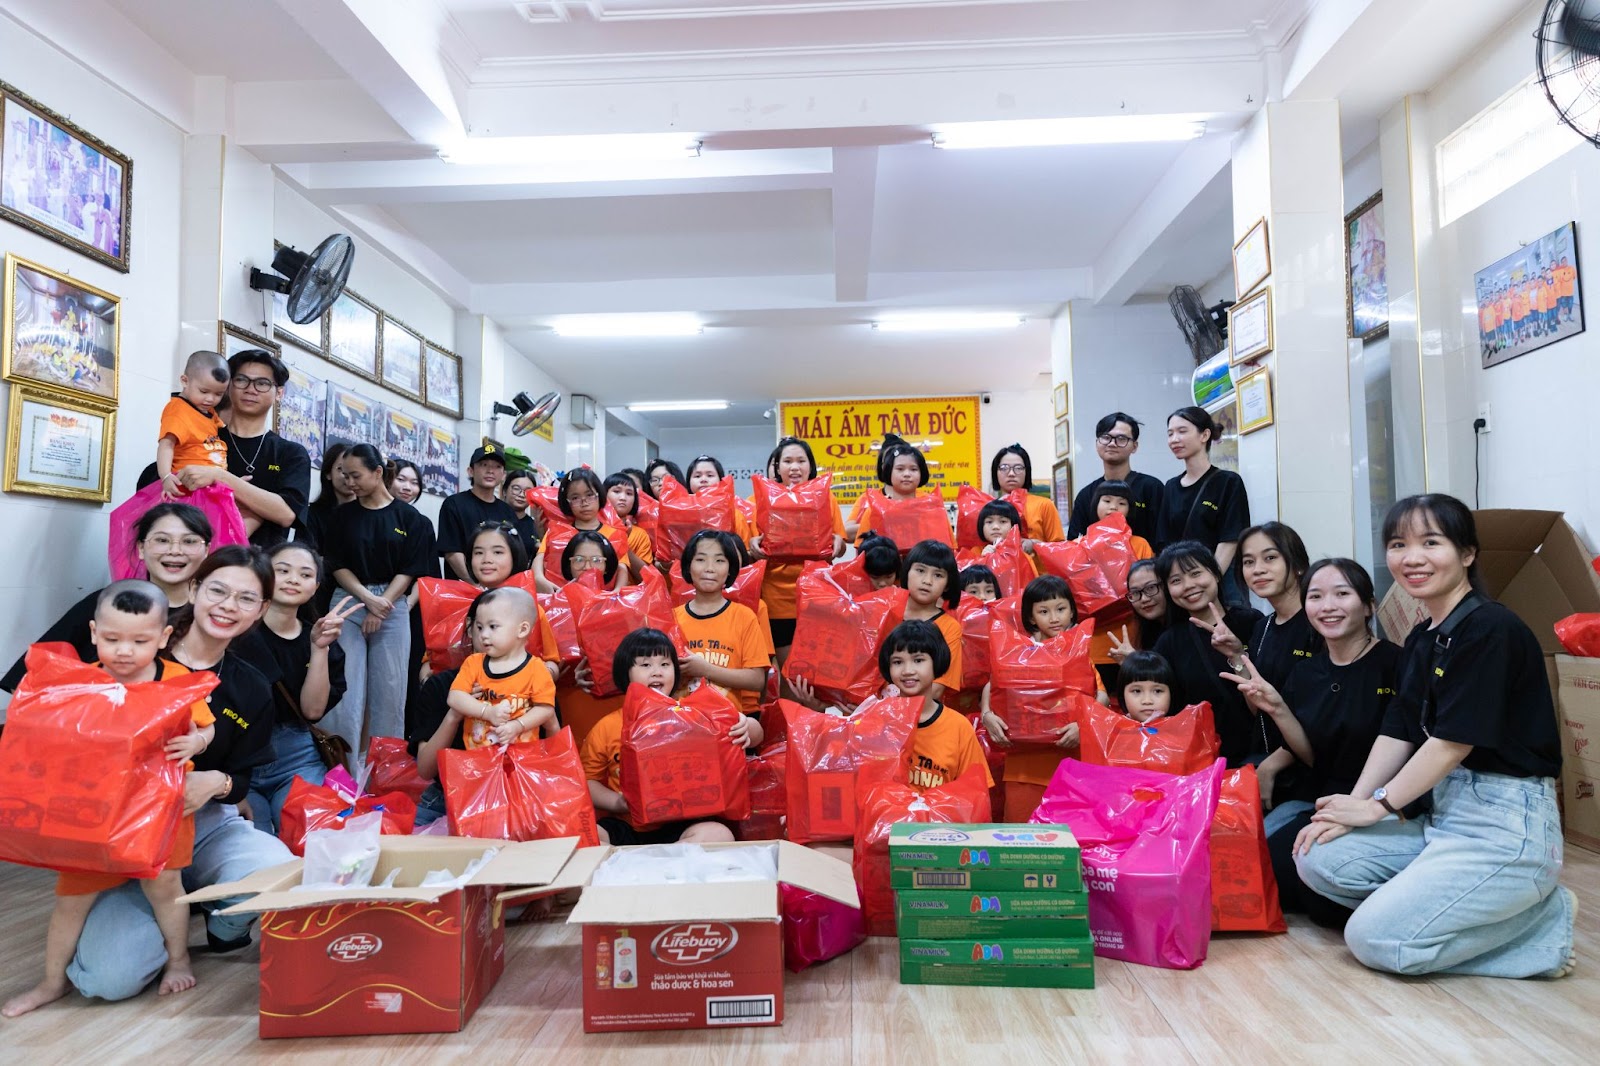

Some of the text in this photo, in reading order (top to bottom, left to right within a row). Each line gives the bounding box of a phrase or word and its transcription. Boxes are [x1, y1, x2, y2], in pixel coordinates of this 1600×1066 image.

[793, 405, 967, 439] MÁI ẤM TÂM ĐỨC
[826, 439, 882, 459] QUẬ
[707, 639, 720, 649] TA
[918, 755, 933, 770] TA
[899, 851, 935, 860] VINAMILK
[1091, 879, 1115, 892] con
[909, 900, 946, 909] VINAMILK
[661, 934, 728, 949] Lifebuoy
[333, 943, 375, 952] Lifebuoy
[910, 947, 947, 956] VINAMILK
[651, 979, 734, 990] thảo dược & hoa sen
